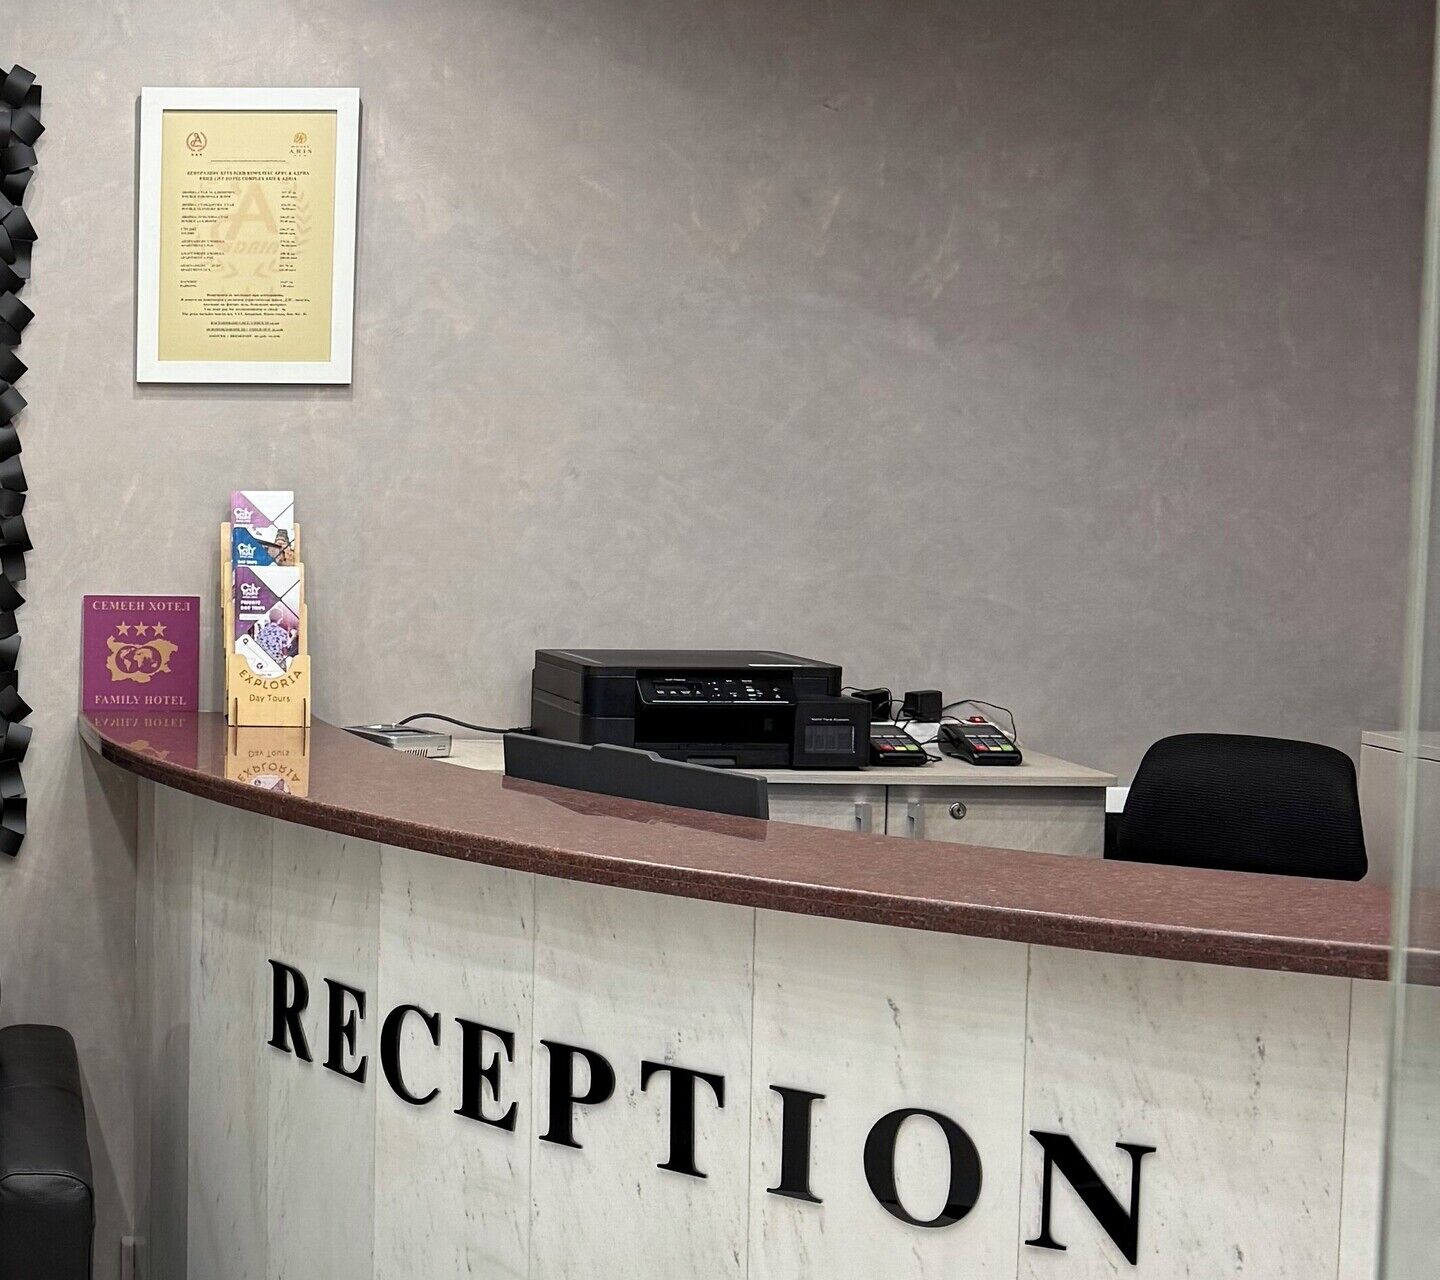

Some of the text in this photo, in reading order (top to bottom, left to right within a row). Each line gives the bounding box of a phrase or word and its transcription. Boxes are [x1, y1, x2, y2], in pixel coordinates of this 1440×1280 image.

[92, 600, 191, 612] СЕМЕЕН ХОТЕЛ
[239, 669, 302, 690] EXPLORIA
[95, 695, 187, 706] FAMILY HOTEL
[249, 694, 291, 703] Day Tours
[266, 958, 1158, 1267] RECEPTION
